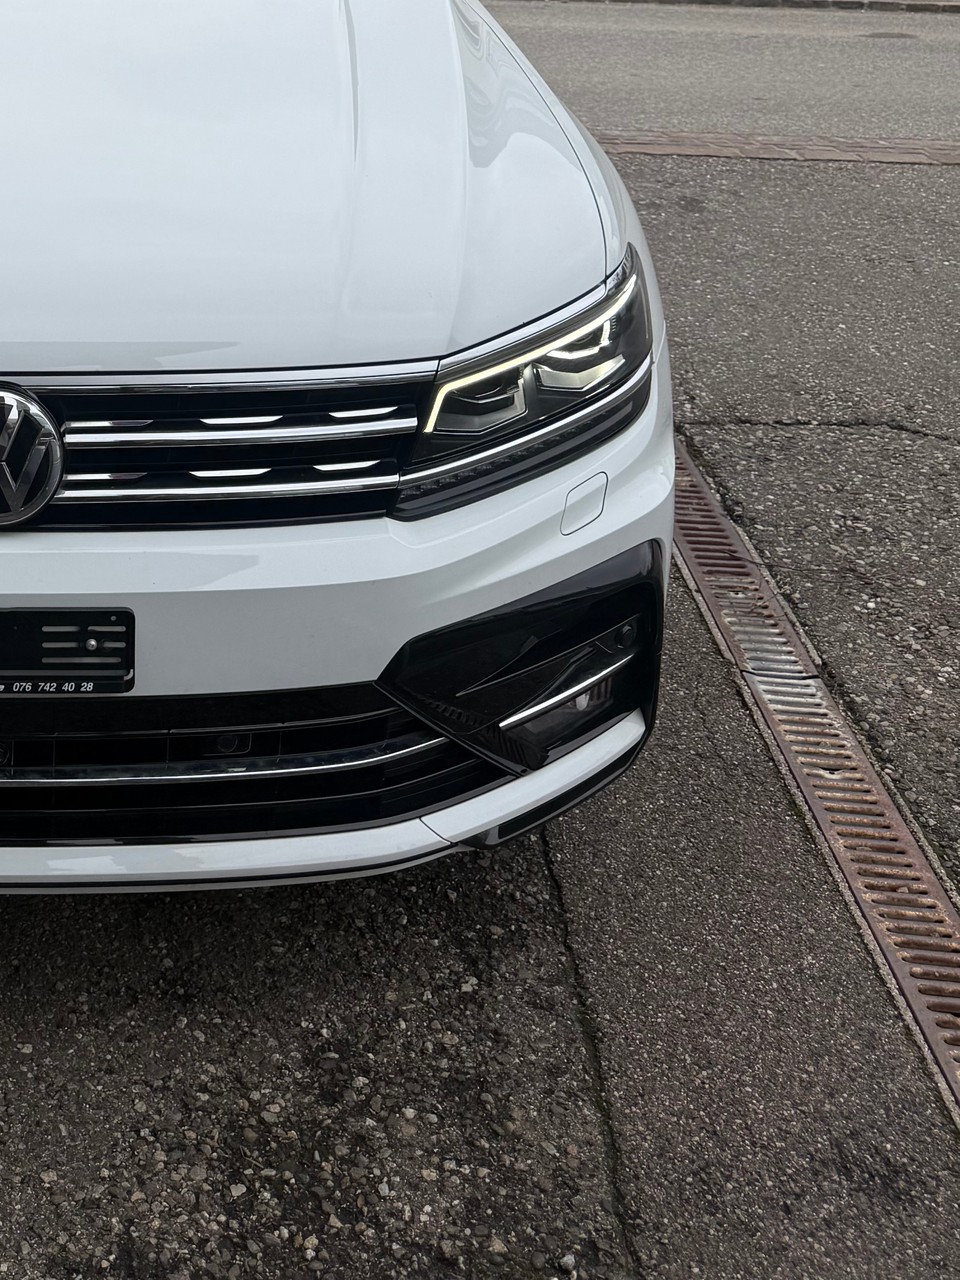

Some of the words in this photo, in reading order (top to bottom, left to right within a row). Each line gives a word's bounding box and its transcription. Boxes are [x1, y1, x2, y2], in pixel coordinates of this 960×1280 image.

[12, 682, 33, 692] 076
[37, 682, 57, 692] 742
[61, 682, 76, 692] 40
[79, 681, 94, 692] 28
